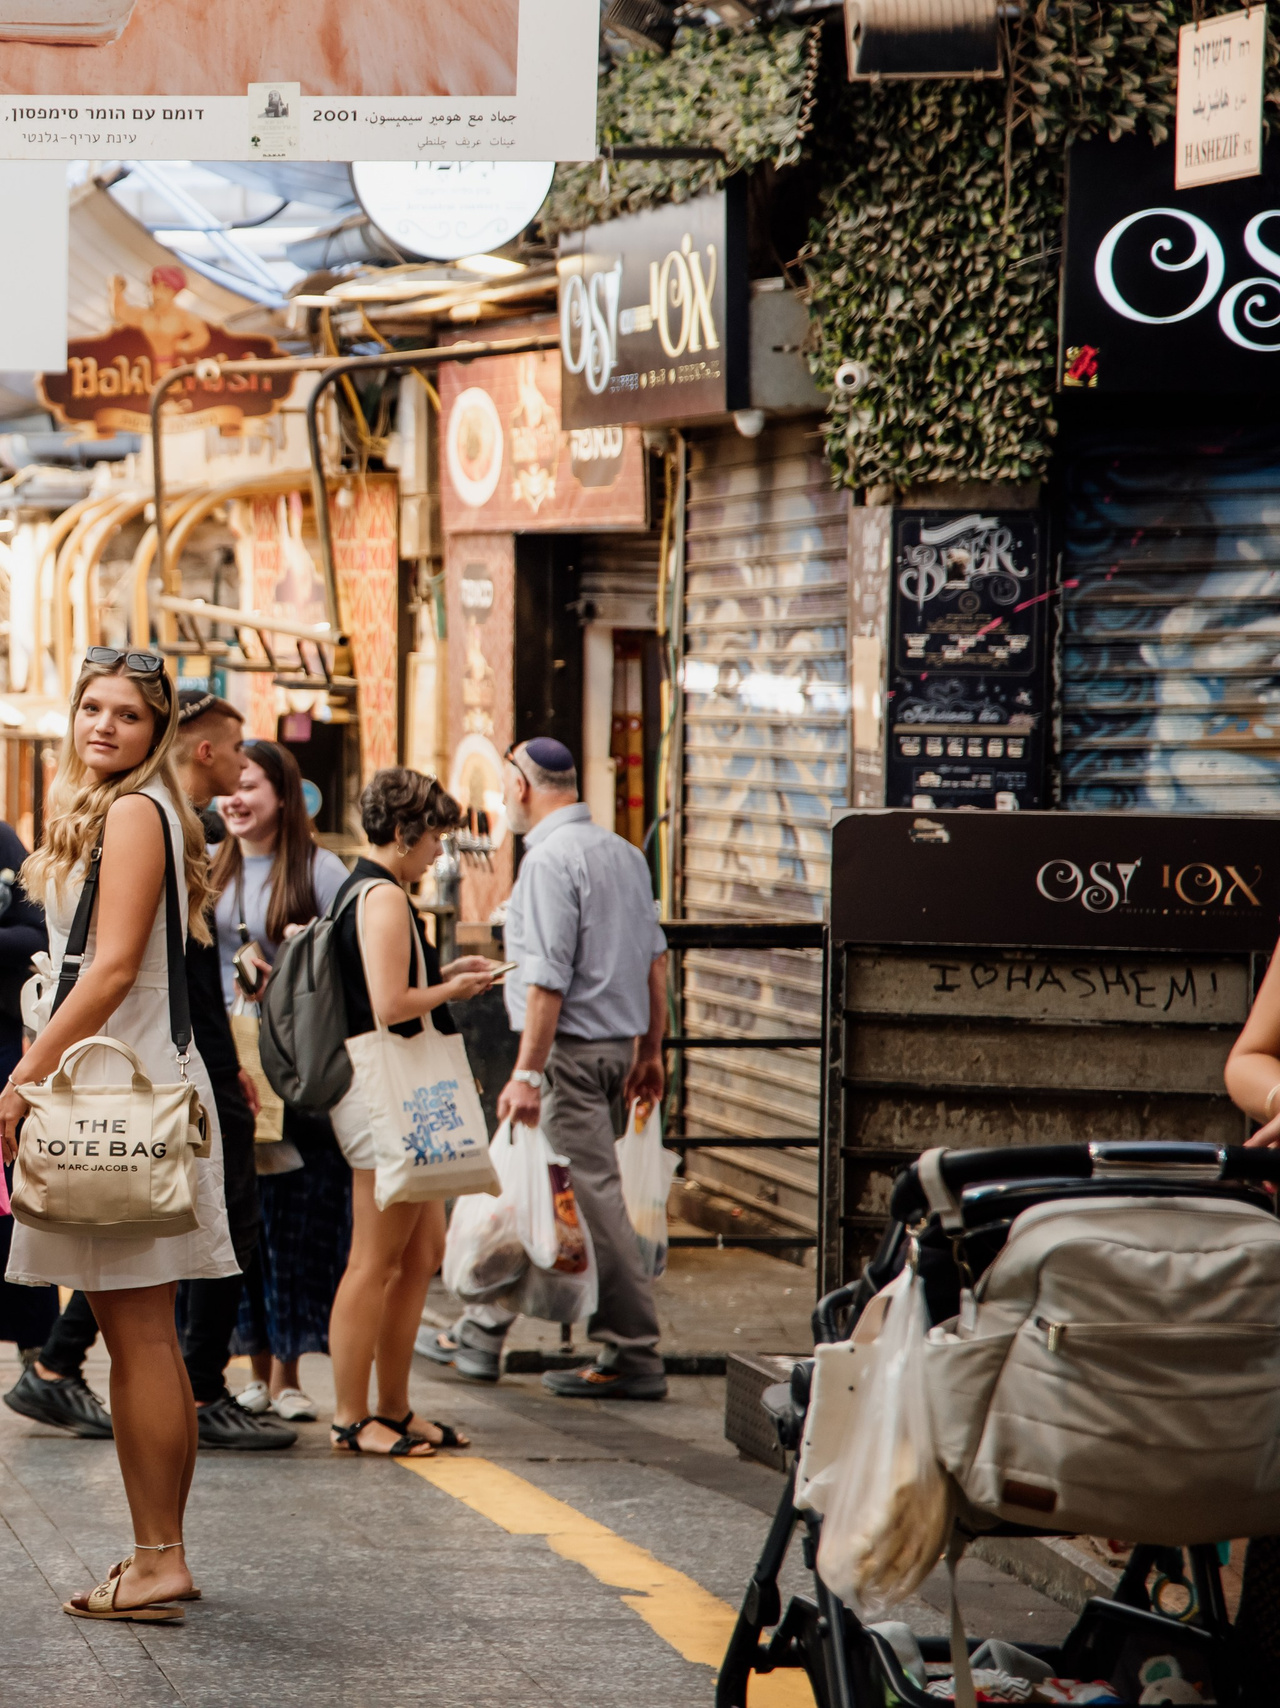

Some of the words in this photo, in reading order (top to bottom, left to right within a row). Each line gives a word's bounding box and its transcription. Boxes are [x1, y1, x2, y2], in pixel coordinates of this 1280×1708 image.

[5, 107, 79, 122] סימפסון,
[85, 107, 126, 120] הומר
[132, 107, 156, 121] עם
[162, 108, 205, 120] דומם
[313, 109, 358, 122] 2001
[428, 112, 462, 127] هومير
[467, 113, 484, 127] مع
[490, 110, 517, 126] جماد
[21, 131, 101, 146] עריף-גלנטי
[106, 133, 138, 144] עינת
[1185, 132, 1240, 168] HASHEZIF
[929, 964, 961, 993] I
[74, 1119, 127, 1135] THE
[36, 1138, 100, 1157] TOTE
[109, 1141, 167, 1159] BAG
[57, 1163, 89, 1172] MARC
[91, 1163, 138, 1173] JACOBS
